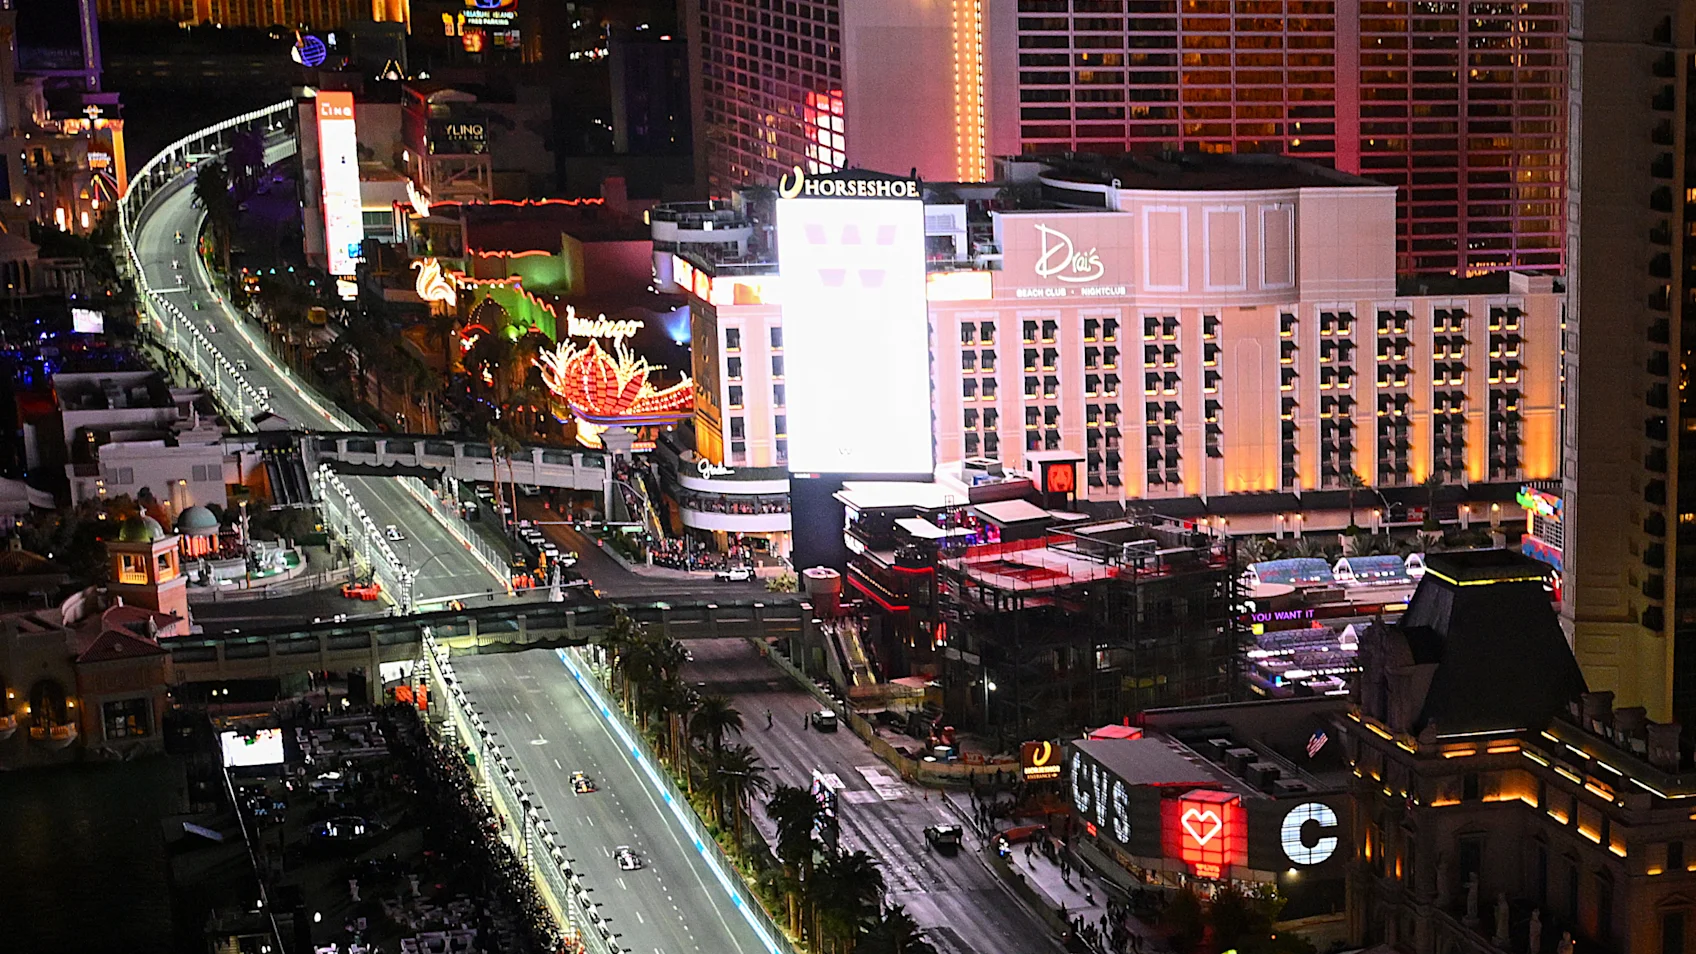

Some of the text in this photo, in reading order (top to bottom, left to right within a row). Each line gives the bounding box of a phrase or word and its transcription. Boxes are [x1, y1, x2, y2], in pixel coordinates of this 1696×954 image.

[321, 106, 352, 116] LINQ
[805, 179, 919, 197] HORSESHOE
[1034, 223, 1104, 282] Drai's
[1016, 286, 1126, 297] BEACH CLUB NIGHTCLUB
[1251, 609, 1314, 622] YOU WANT IT
[1071, 751, 1131, 843] CVS
[1280, 802, 1338, 865] C
